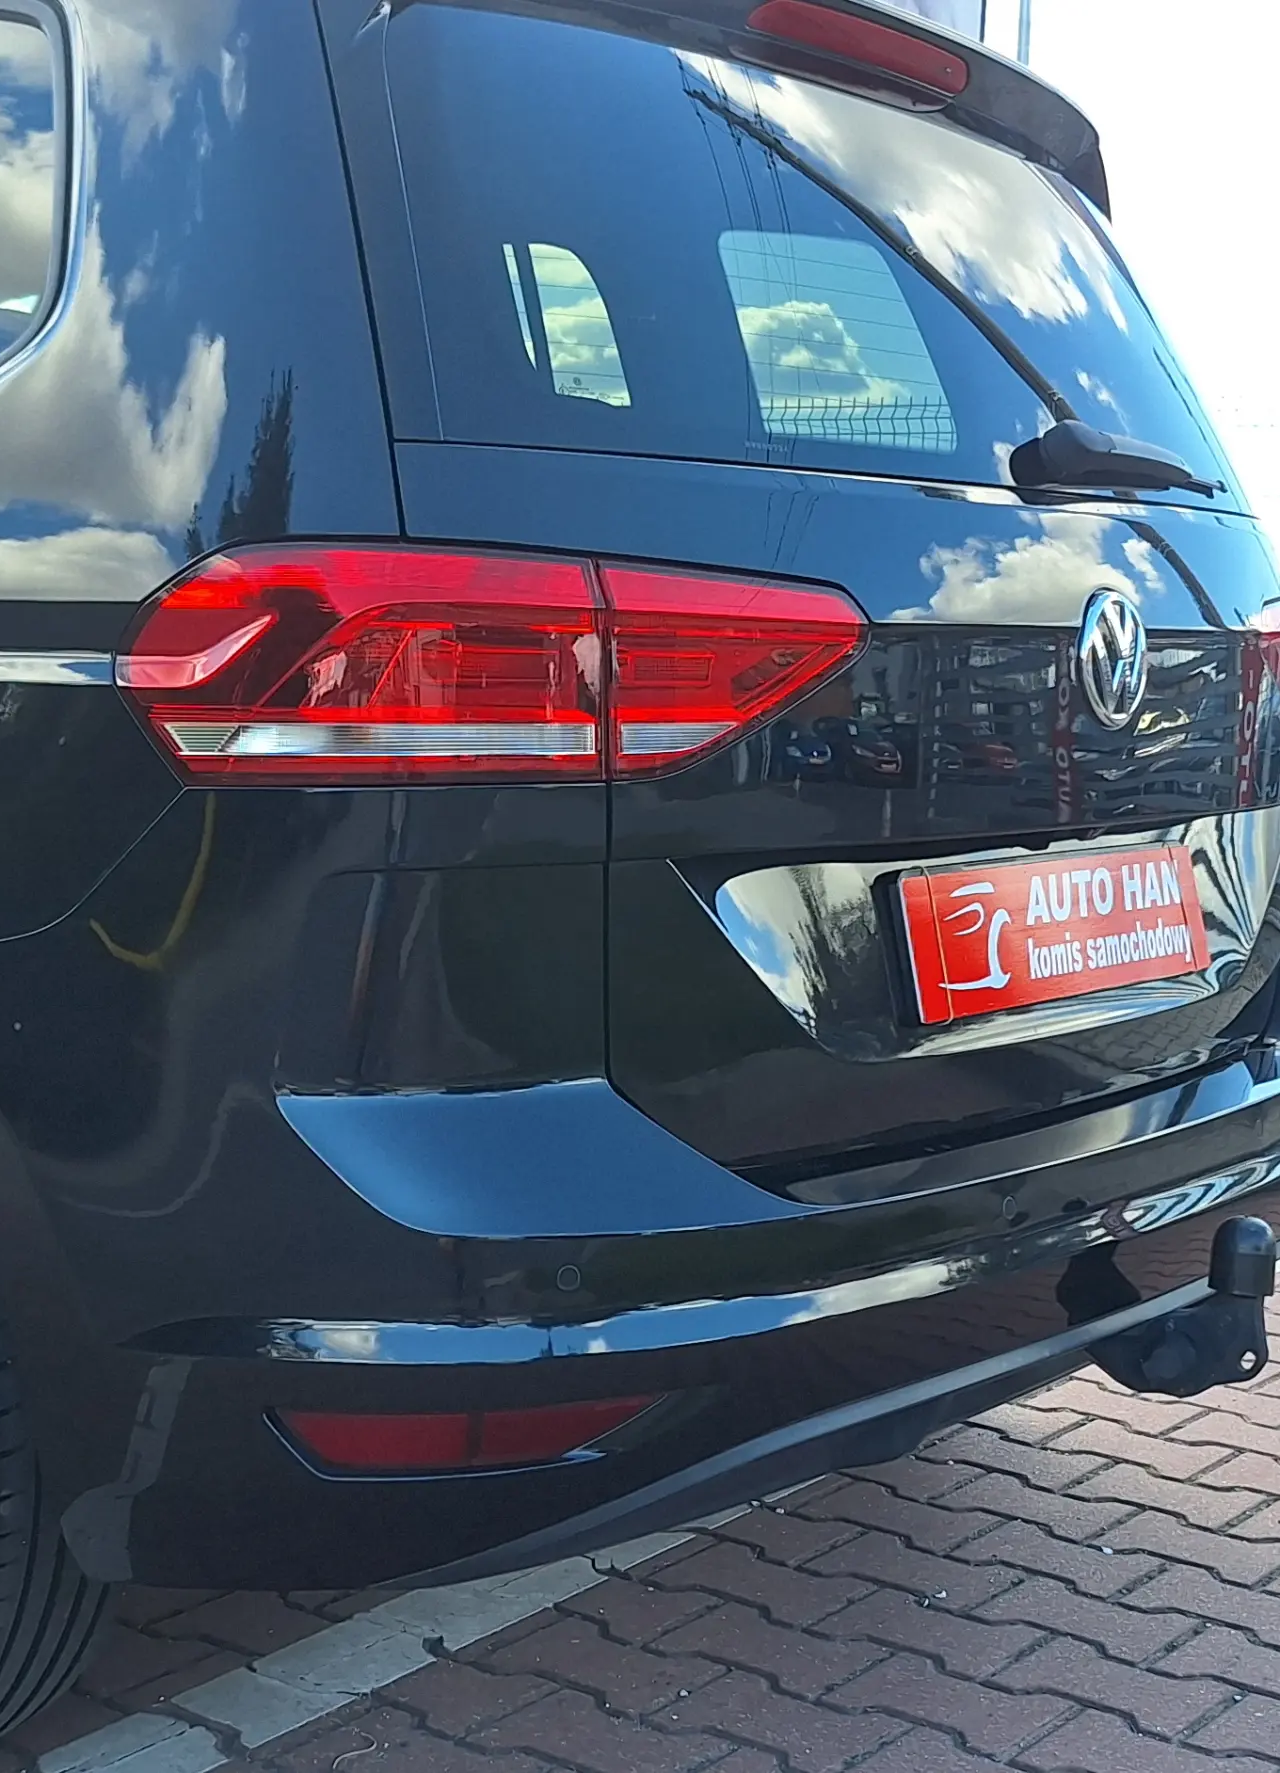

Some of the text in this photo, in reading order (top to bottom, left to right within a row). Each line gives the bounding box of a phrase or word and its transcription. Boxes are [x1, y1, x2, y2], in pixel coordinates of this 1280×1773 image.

[1025, 859, 1182, 927] AUTO HAN
[1027, 916, 1192, 980] komis samochodowy
